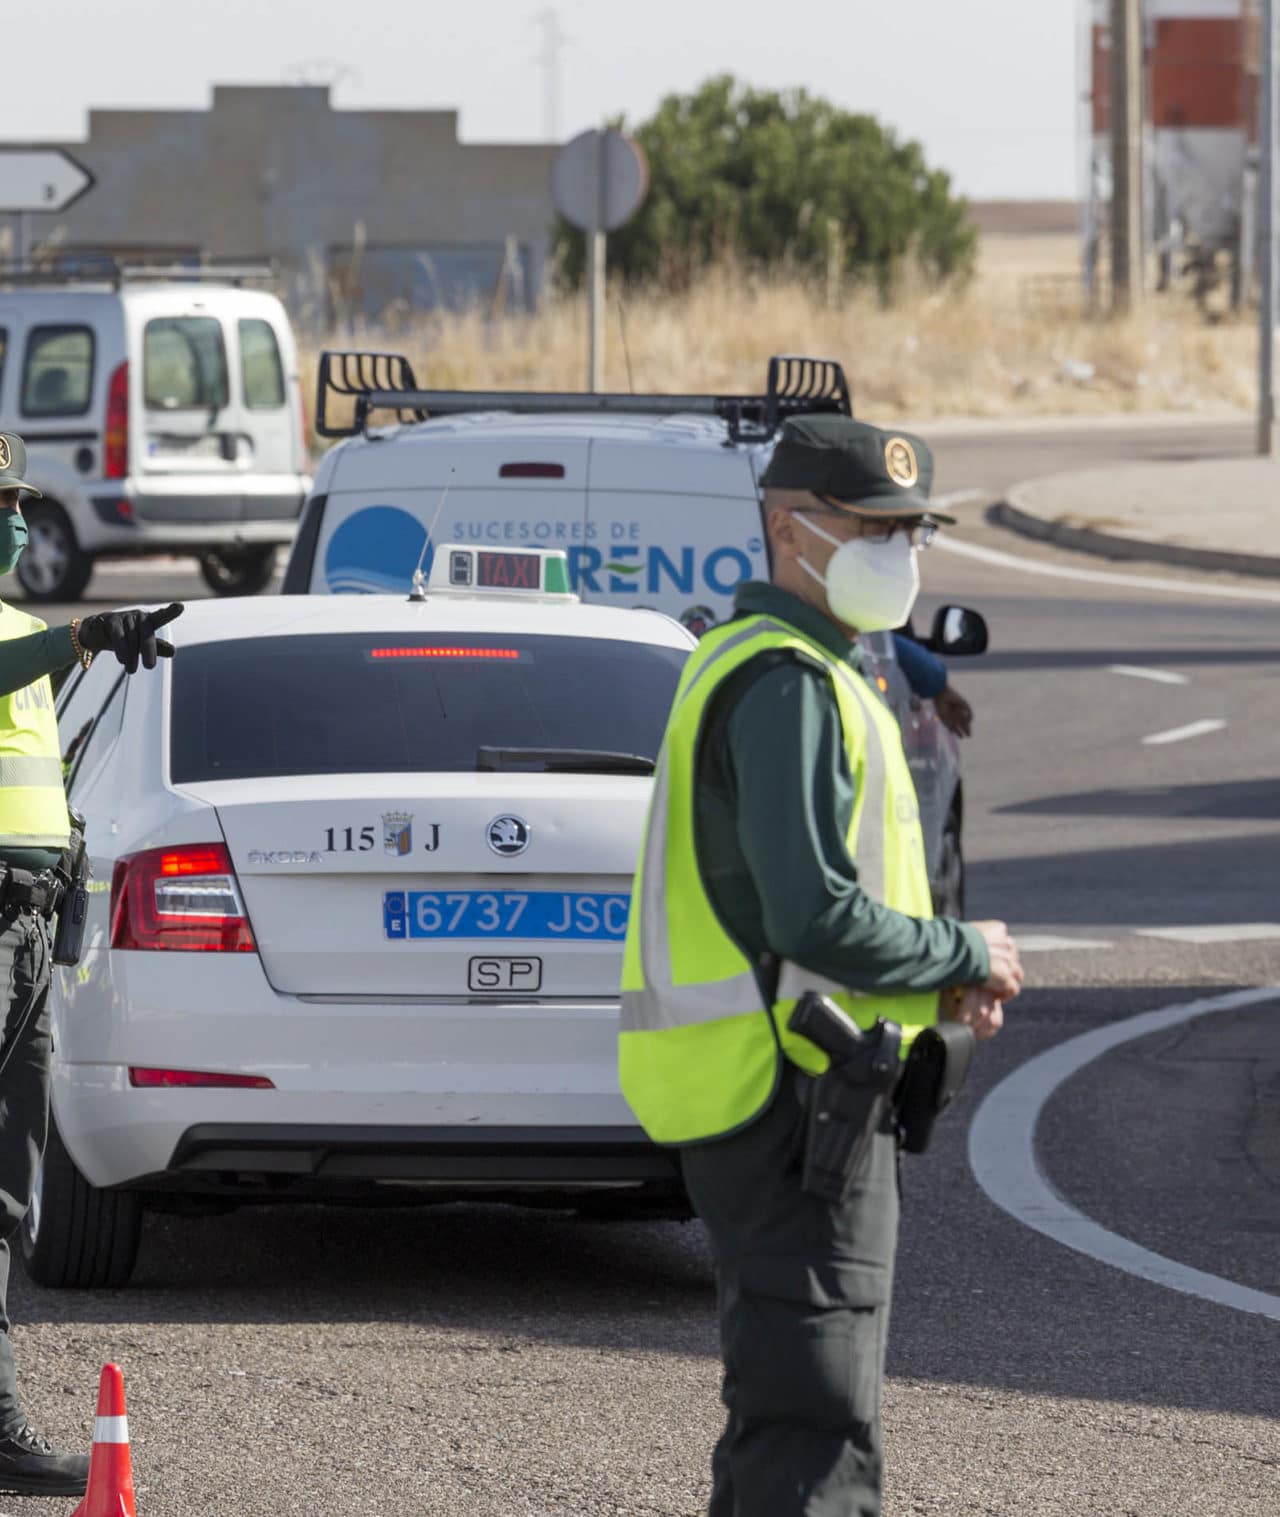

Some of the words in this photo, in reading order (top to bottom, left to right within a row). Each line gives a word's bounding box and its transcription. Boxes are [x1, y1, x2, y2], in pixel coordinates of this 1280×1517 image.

[453, 521, 599, 541] SUCESORES
[611, 521, 641, 540] DE
[479, 553, 539, 588] TAXI
[525, 545, 753, 597] RENO
[323, 826, 375, 852] 115
[425, 823, 441, 852] J
[391, 919, 401, 931] E
[416, 894, 529, 932] 6737
[547, 896, 628, 934] JSC
[477, 961, 533, 987] SP
